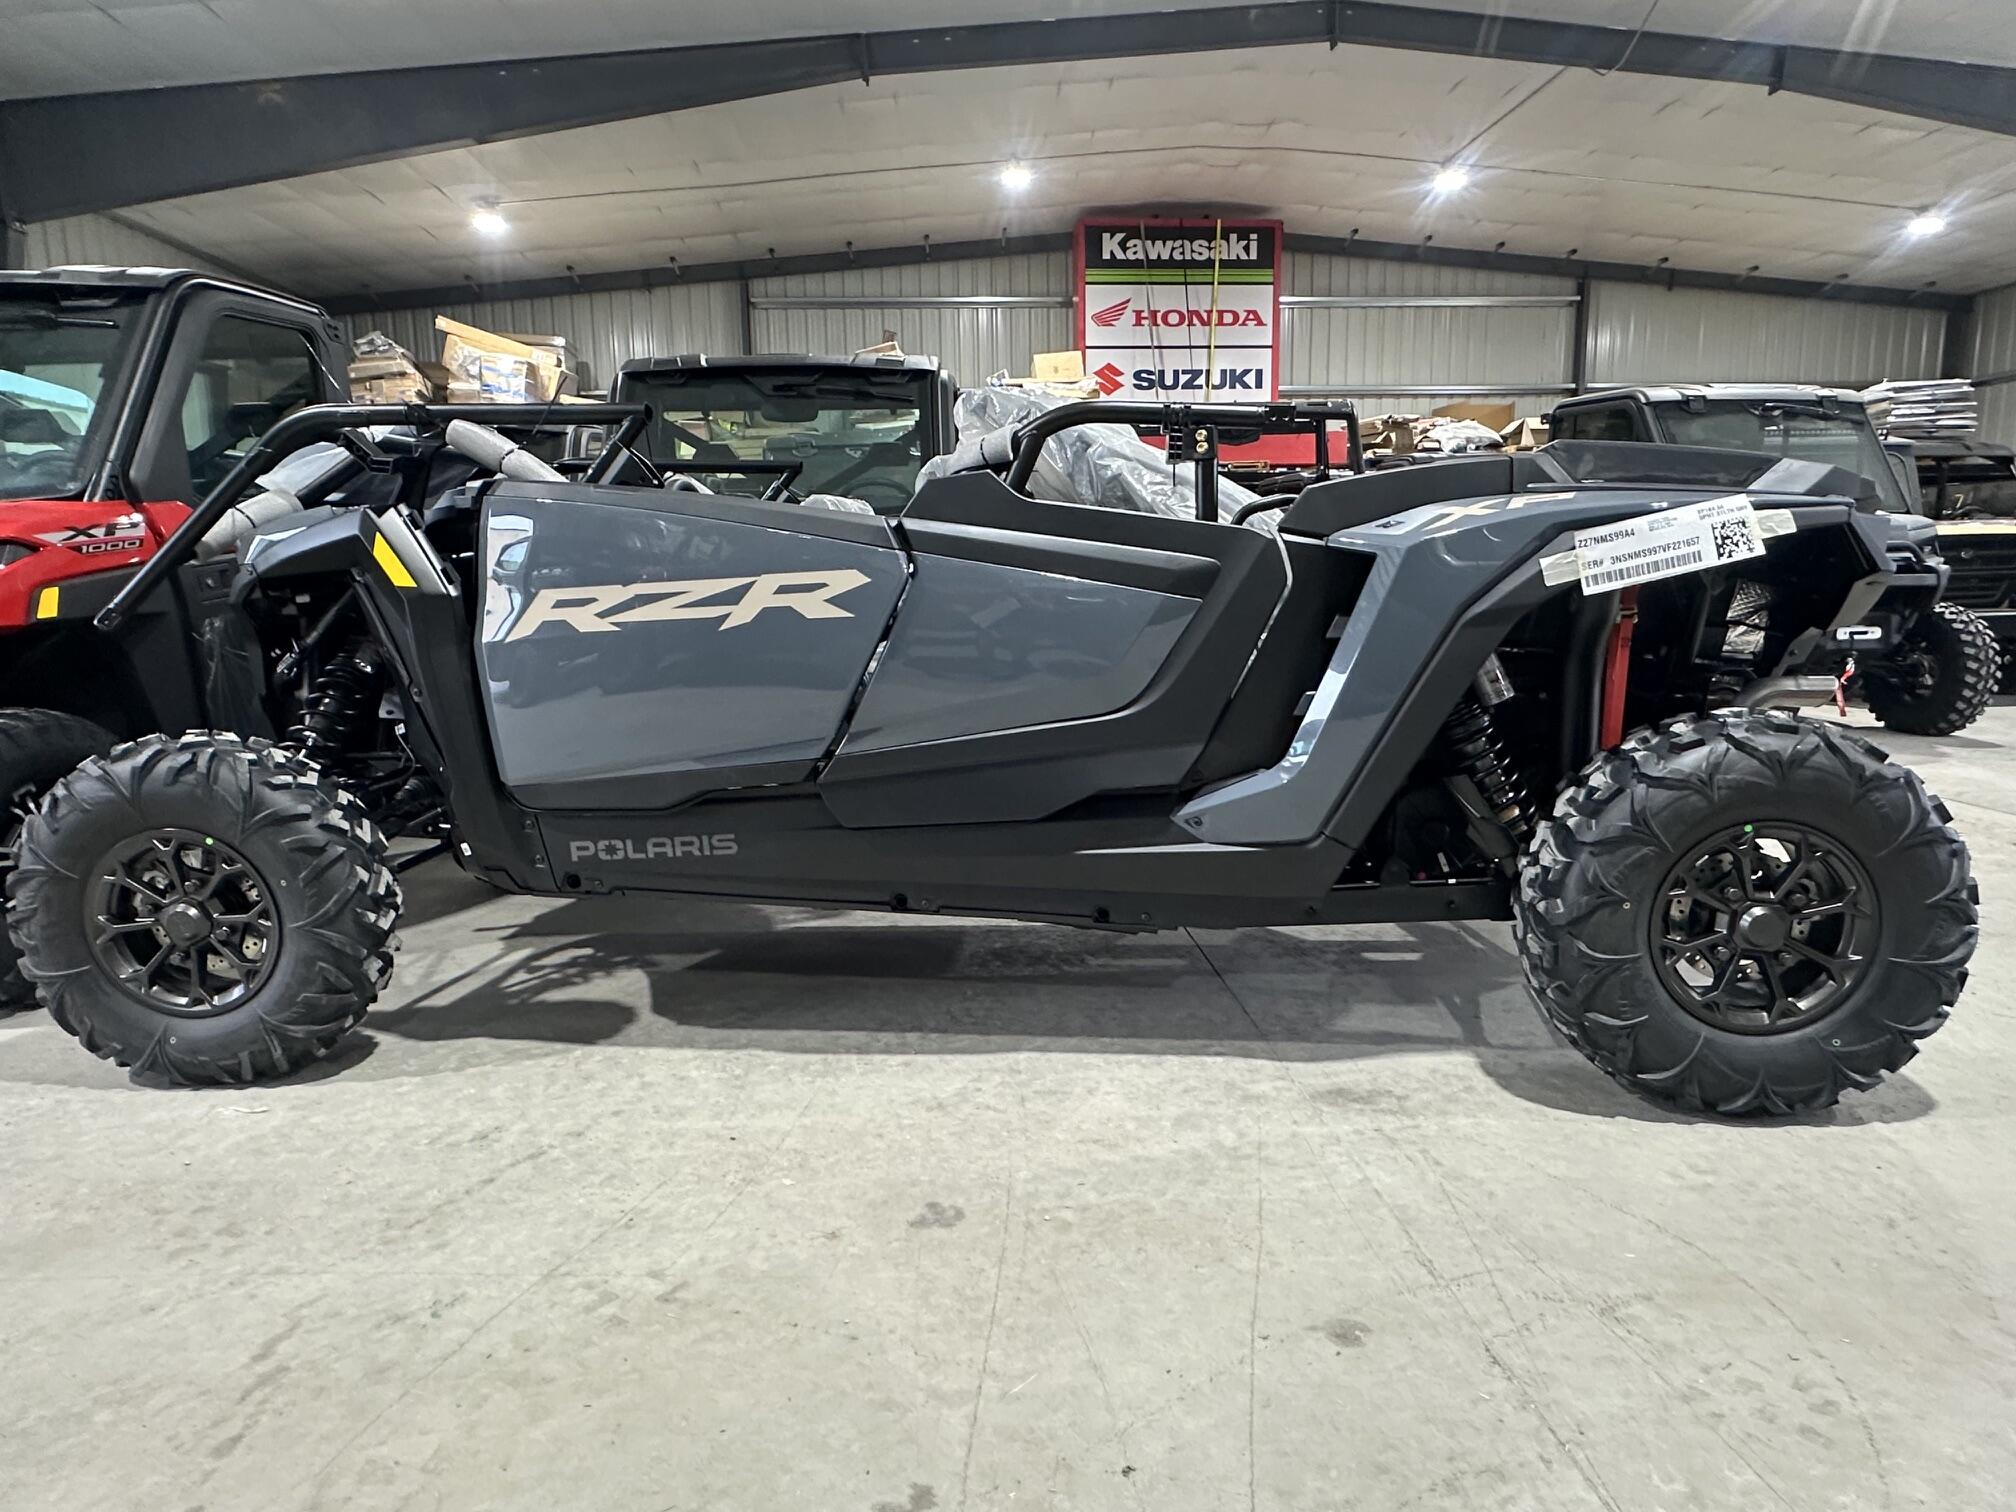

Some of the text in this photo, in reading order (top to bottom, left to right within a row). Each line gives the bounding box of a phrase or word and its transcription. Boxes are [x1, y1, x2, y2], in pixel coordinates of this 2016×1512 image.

[1102, 232, 1258, 261] Kawasaki
[1132, 309, 1267, 327] HONDA
[1132, 368, 1264, 390] SUZUKI
[59, 521, 140, 543] XP
[1577, 528, 1636, 549] Z27NMS99A4
[81, 539, 141, 554] 1000
[505, 569, 872, 643] RZR
[569, 833, 739, 862] POLARIS
